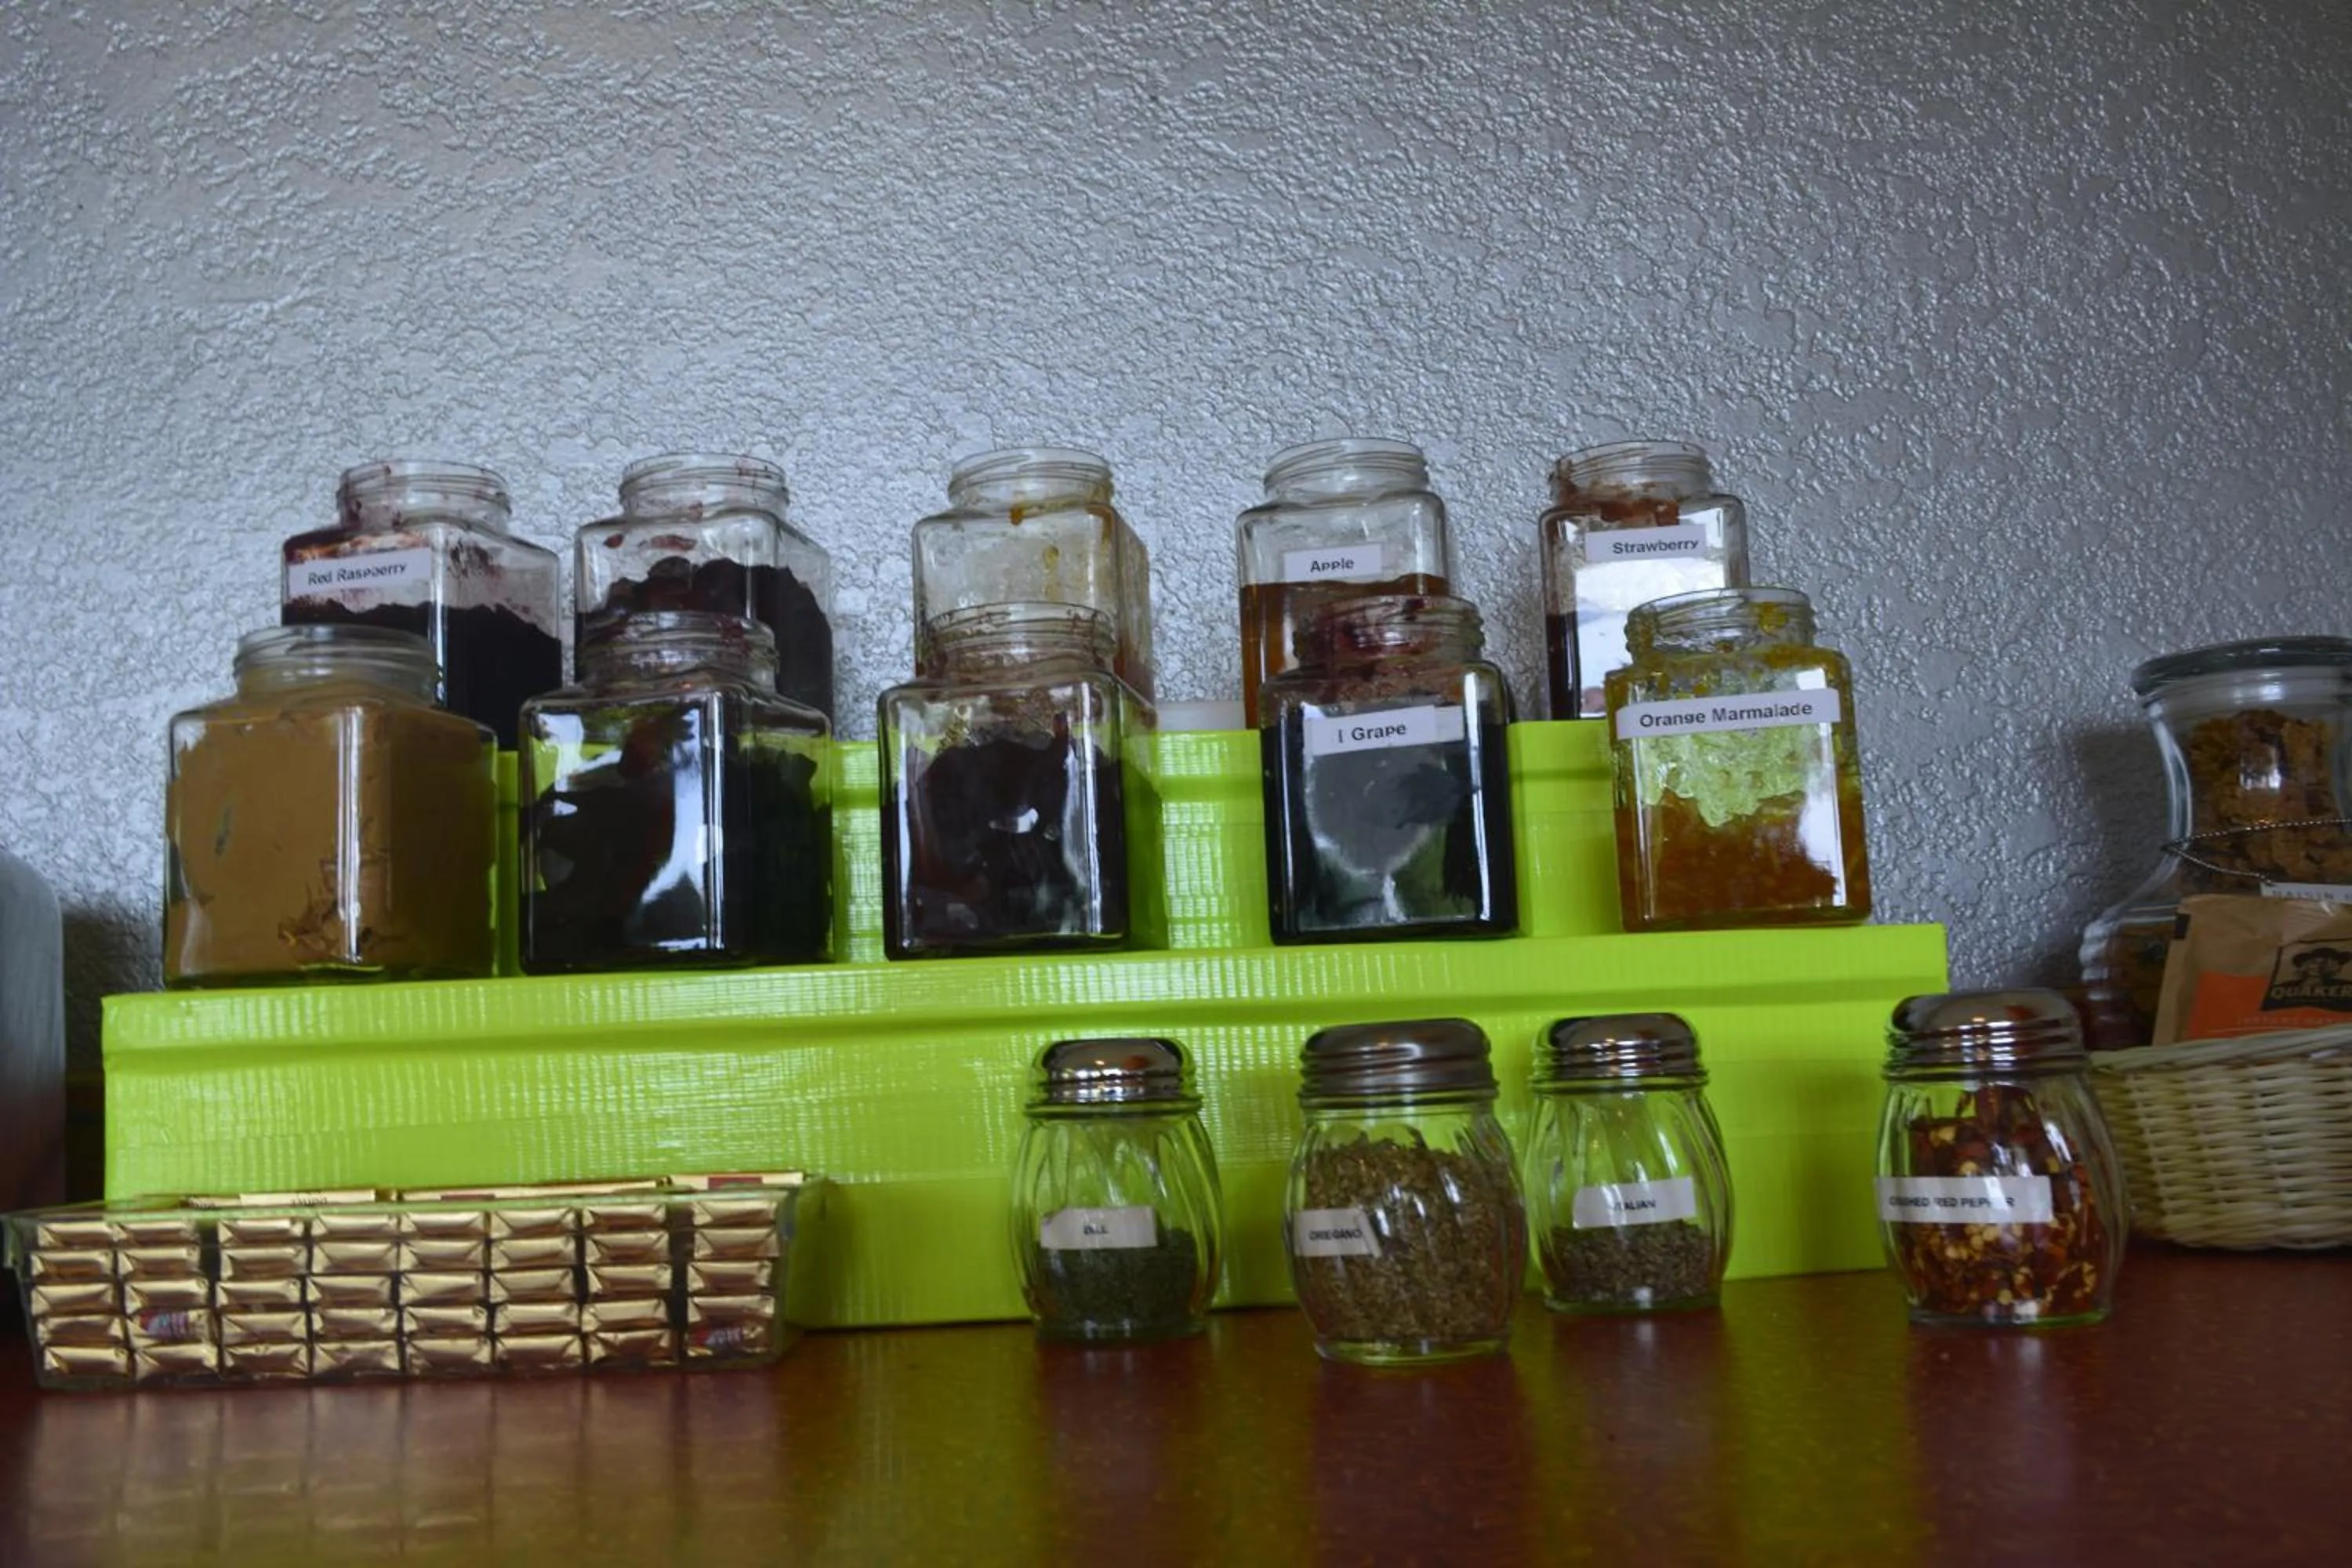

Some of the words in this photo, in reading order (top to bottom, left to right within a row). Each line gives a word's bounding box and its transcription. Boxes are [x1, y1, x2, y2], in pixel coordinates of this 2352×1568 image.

[1612, 539, 1699, 554] Strawberry
[1310, 557, 1355, 573] Apple
[307, 571, 332, 585] Red
[1639, 711, 1706, 728] Orange
[1712, 701, 1813, 722] Marmalade
[1351, 723, 1407, 741] Grape
[2270, 984, 2352, 1000] QUAKER
[1960, 1196, 2016, 1208] PEPR
